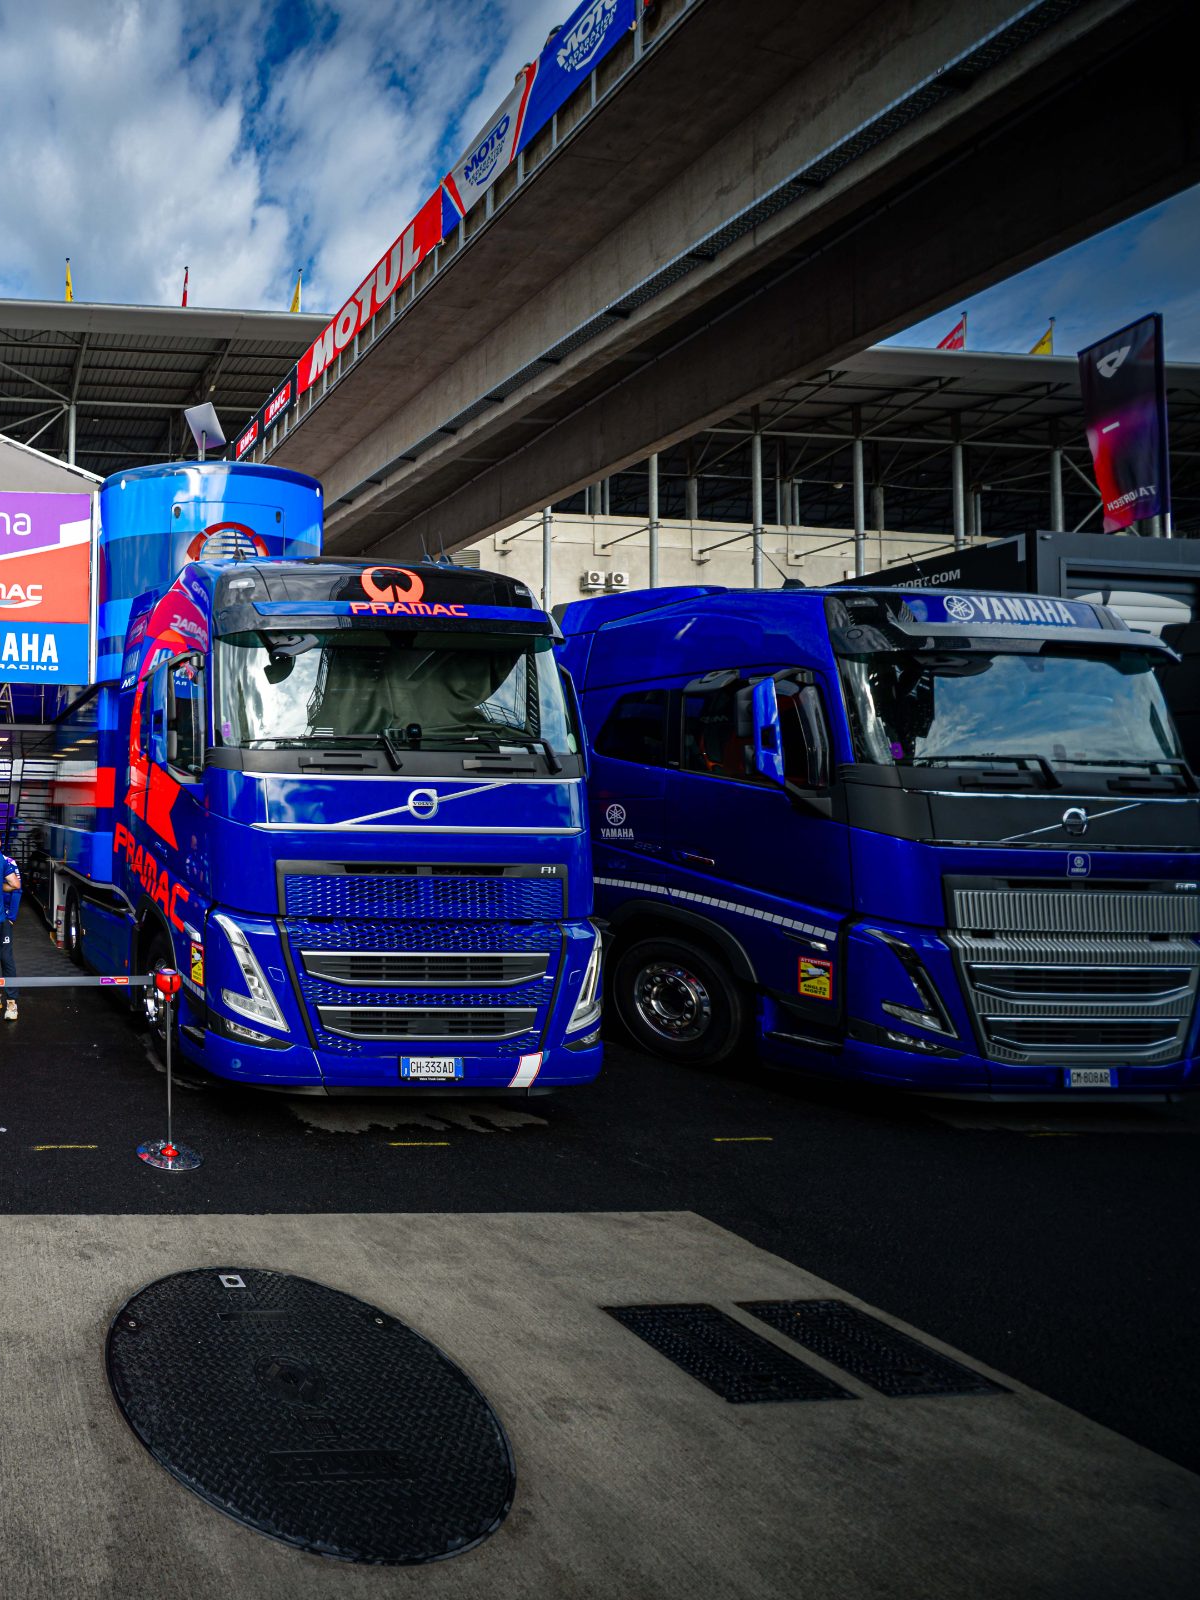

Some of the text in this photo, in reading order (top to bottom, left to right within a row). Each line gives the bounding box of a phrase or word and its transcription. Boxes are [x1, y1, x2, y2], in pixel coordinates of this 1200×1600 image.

[464, 115, 511, 180] MOTO
[308, 223, 422, 385] MOTUL
[269, 389, 287, 419] RMC
[349, 602, 469, 617] PRAMAC
[970, 595, 1077, 624] YAMAHA
[600, 828, 634, 838] YAMAHA
[113, 822, 190, 933] PRAMAC
[541, 866, 557, 874] FH
